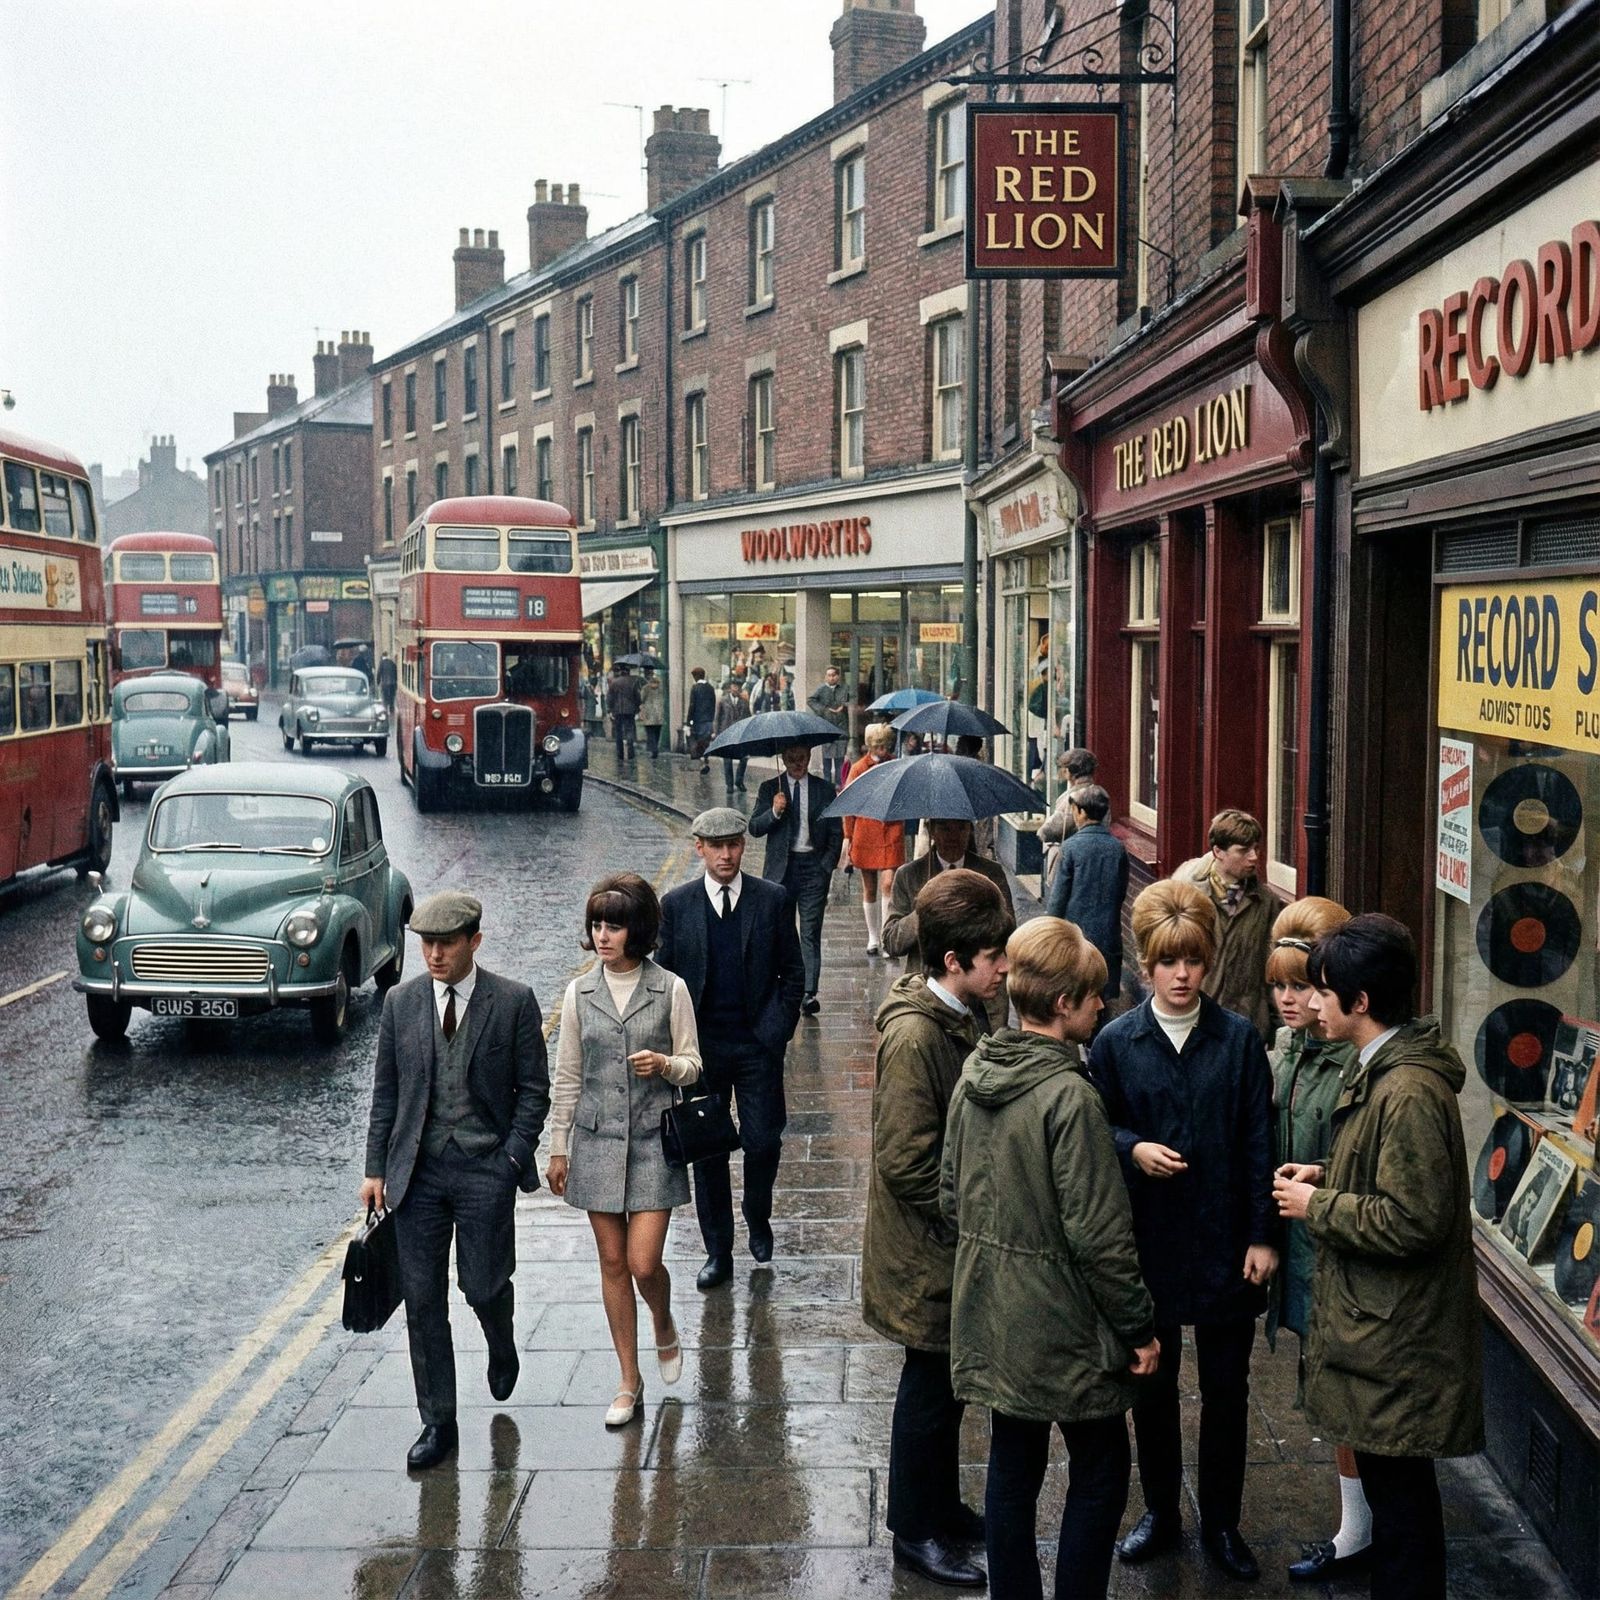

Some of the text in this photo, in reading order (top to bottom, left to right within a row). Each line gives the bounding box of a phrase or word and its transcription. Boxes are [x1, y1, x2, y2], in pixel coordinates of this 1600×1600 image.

[1011, 129, 1081, 156] THE
[995, 166, 1097, 203] RED
[985, 212, 1105, 250] LION
[1419, 220, 1600, 411] RECORD
[1113, 383, 1250, 492] THE RED LION
[741, 516, 872, 564] WOOLWORTHS
[529, 600, 544, 616] 18
[1457, 594, 1561, 690] RECORD
[156, 999, 194, 1015] GWS
